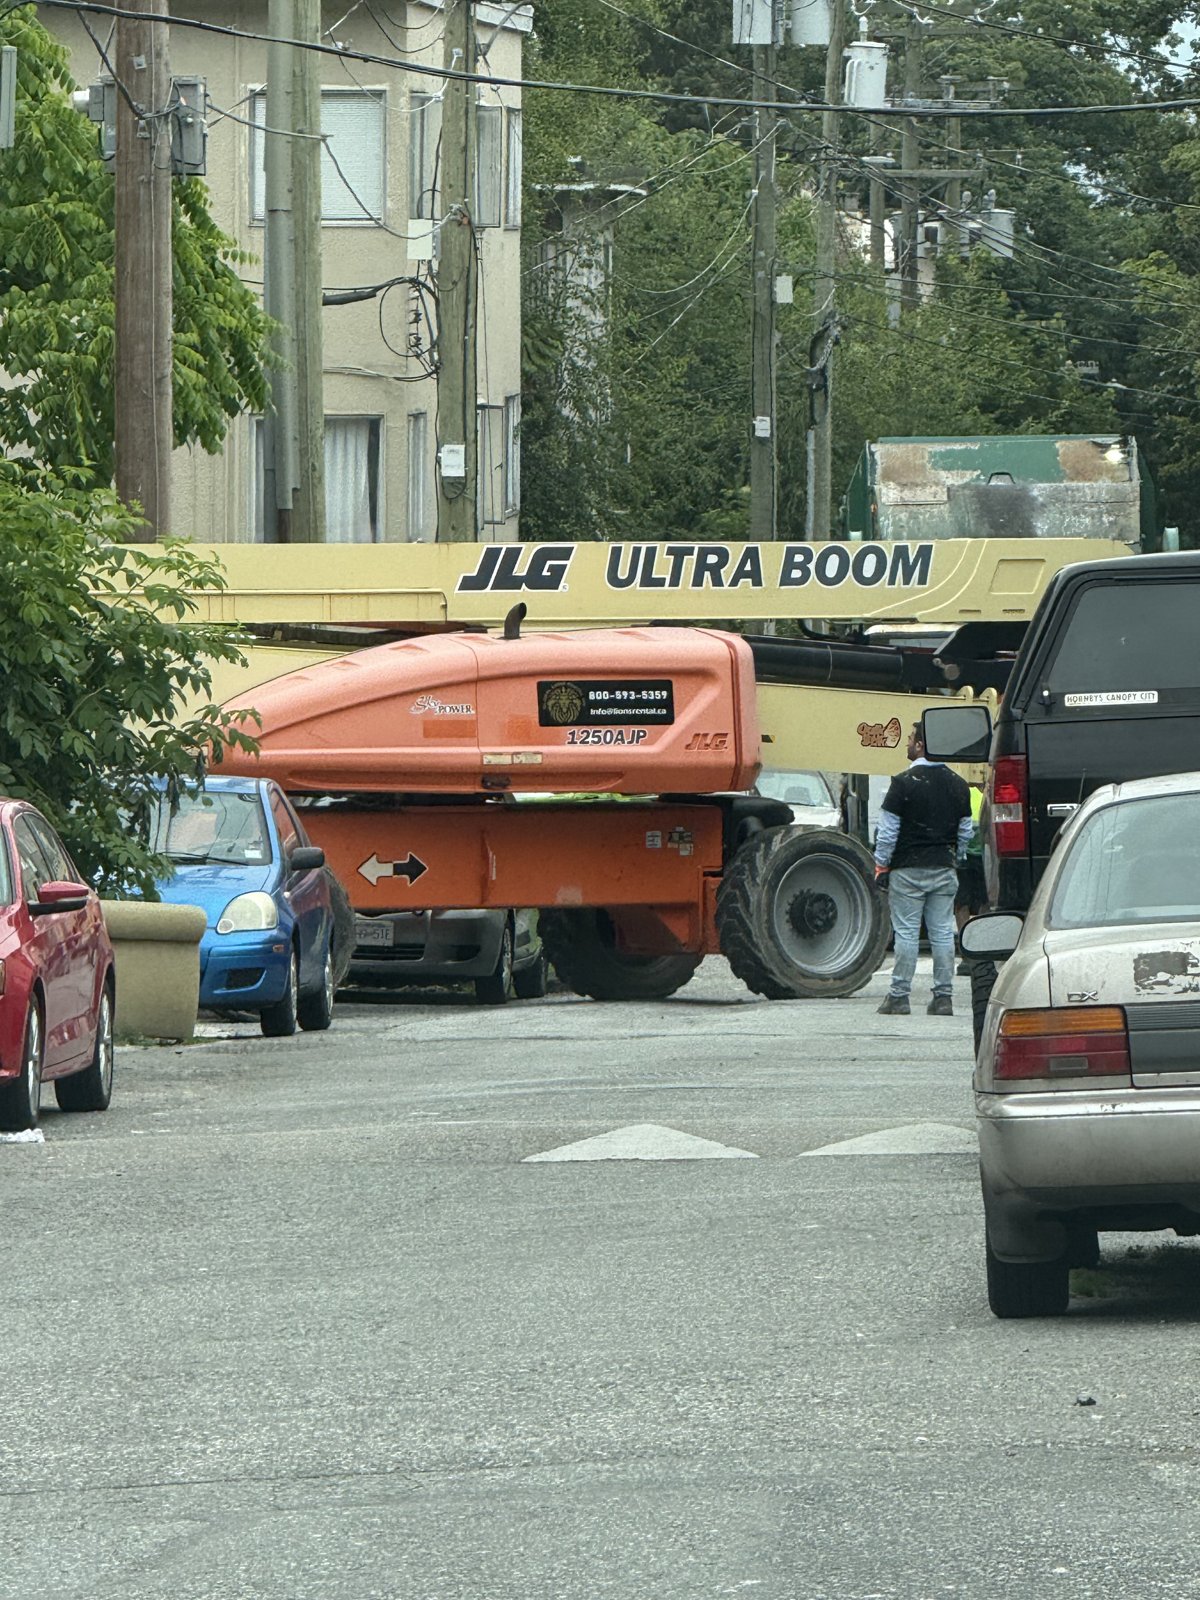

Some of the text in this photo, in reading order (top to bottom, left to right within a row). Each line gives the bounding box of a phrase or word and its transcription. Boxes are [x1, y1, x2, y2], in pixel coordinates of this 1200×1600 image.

[456, 543, 934, 593] JLG ULTRA BOOM
[588, 690, 668, 700] 800-593-5359
[1106, 692, 1138, 701] CANOPY
[1140, 691, 1156, 700] CITY
[566, 729, 648, 745] 1250AJP
[684, 732, 729, 751] JLG
